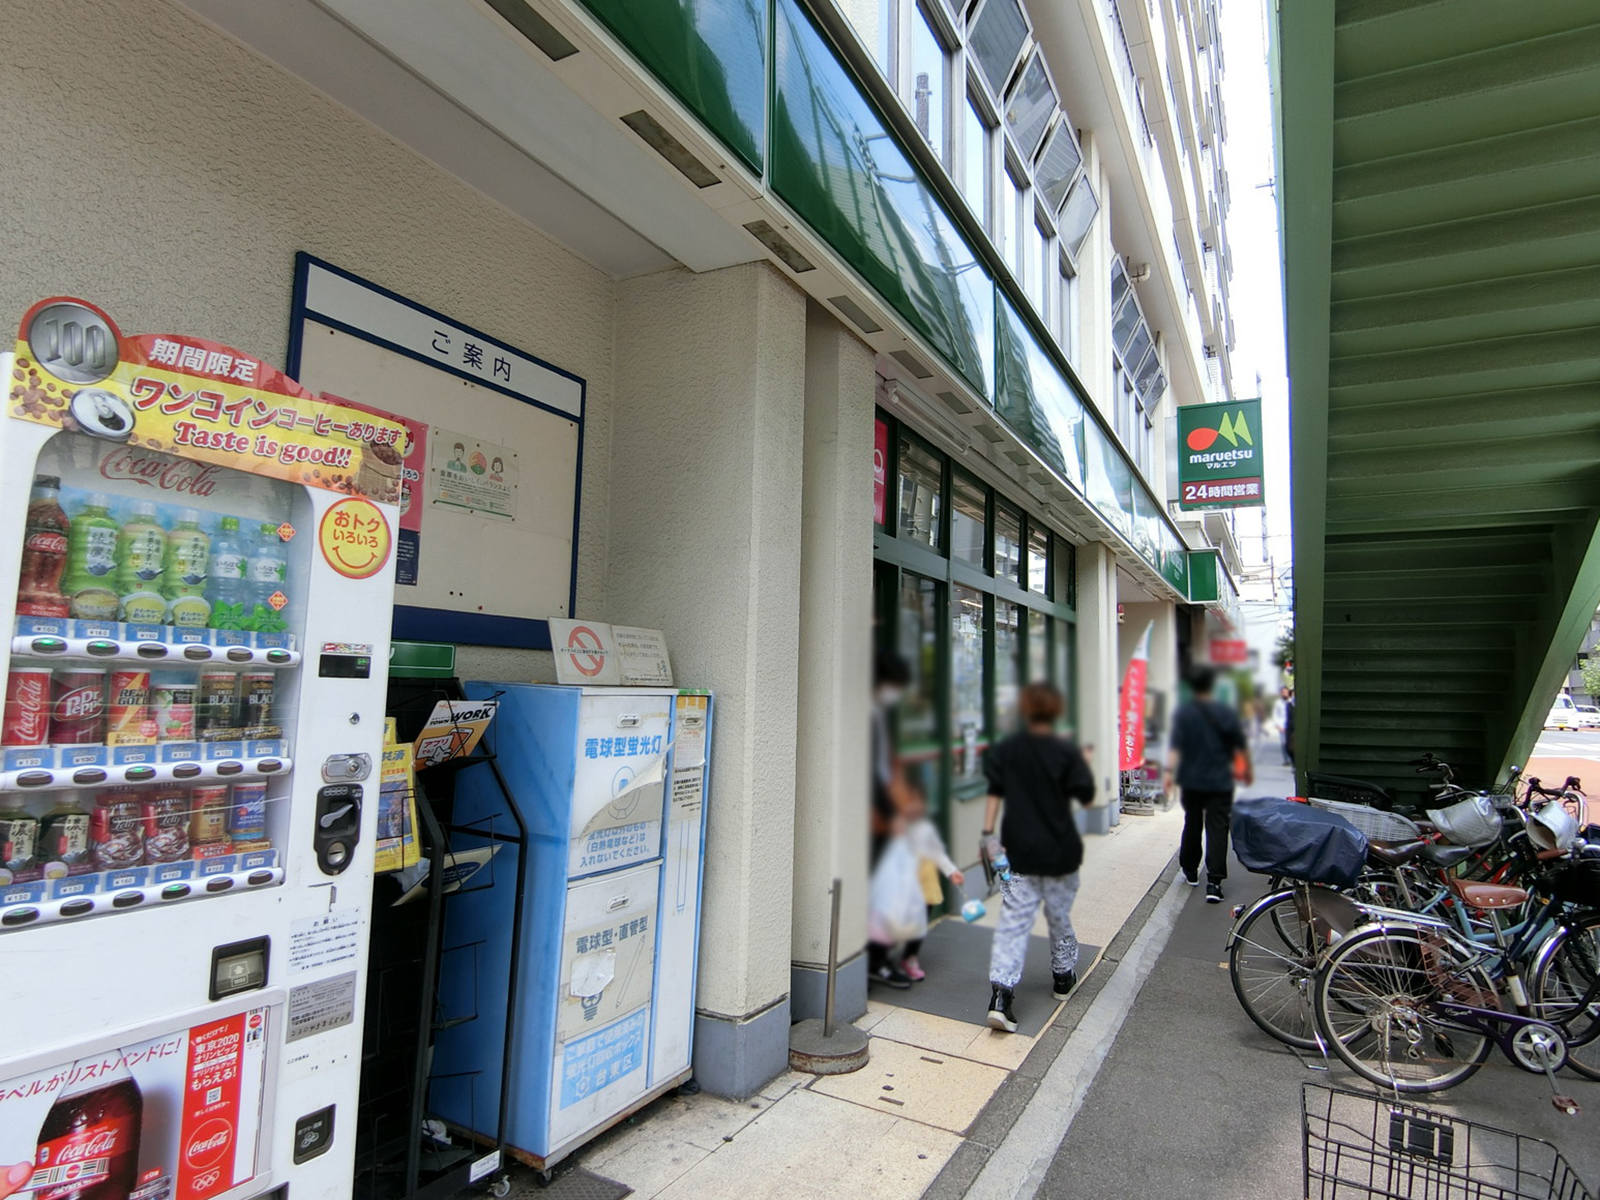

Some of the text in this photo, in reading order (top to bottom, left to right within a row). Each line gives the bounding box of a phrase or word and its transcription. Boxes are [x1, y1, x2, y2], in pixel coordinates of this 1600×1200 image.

[45, 319, 105, 370] 100
[431, 329, 511, 383] ご案内
[148, 337, 258, 383] 期間限定
[132, 376, 404, 446] ワンコインコーヒーあります
[174, 419, 353, 467] Taste is good!!
[1189, 449, 1253, 464] maruetsu
[1205, 460, 1237, 470] マルエツ
[100, 446, 225, 498] Coca-Cola
[1184, 482, 1259, 501] 24時間営業
[333, 509, 382, 534] おトク
[333, 528, 380, 550] いろいろ
[15, 677, 42, 741] Coca-Cola
[81, 690, 100, 703] Dr
[429, 707, 493, 726] TOWN WORK
[423, 738, 449, 749] アプリ
[584, 735, 663, 760] 電球型蛍光灯
[586, 832, 646, 854] (白熱電球など)は
[579, 844, 651, 868] 入れないでください。
[576, 915, 649, 954] 電球型・直管型
[195, 1032, 240, 1056] 東京2020
[191, 1065, 238, 1091] もらえる!
[596, 1051, 634, 1088] 台東区
[56, 1128, 120, 1165] Coca-Cola
[188, 1129, 230, 1157] Coca-Cola
